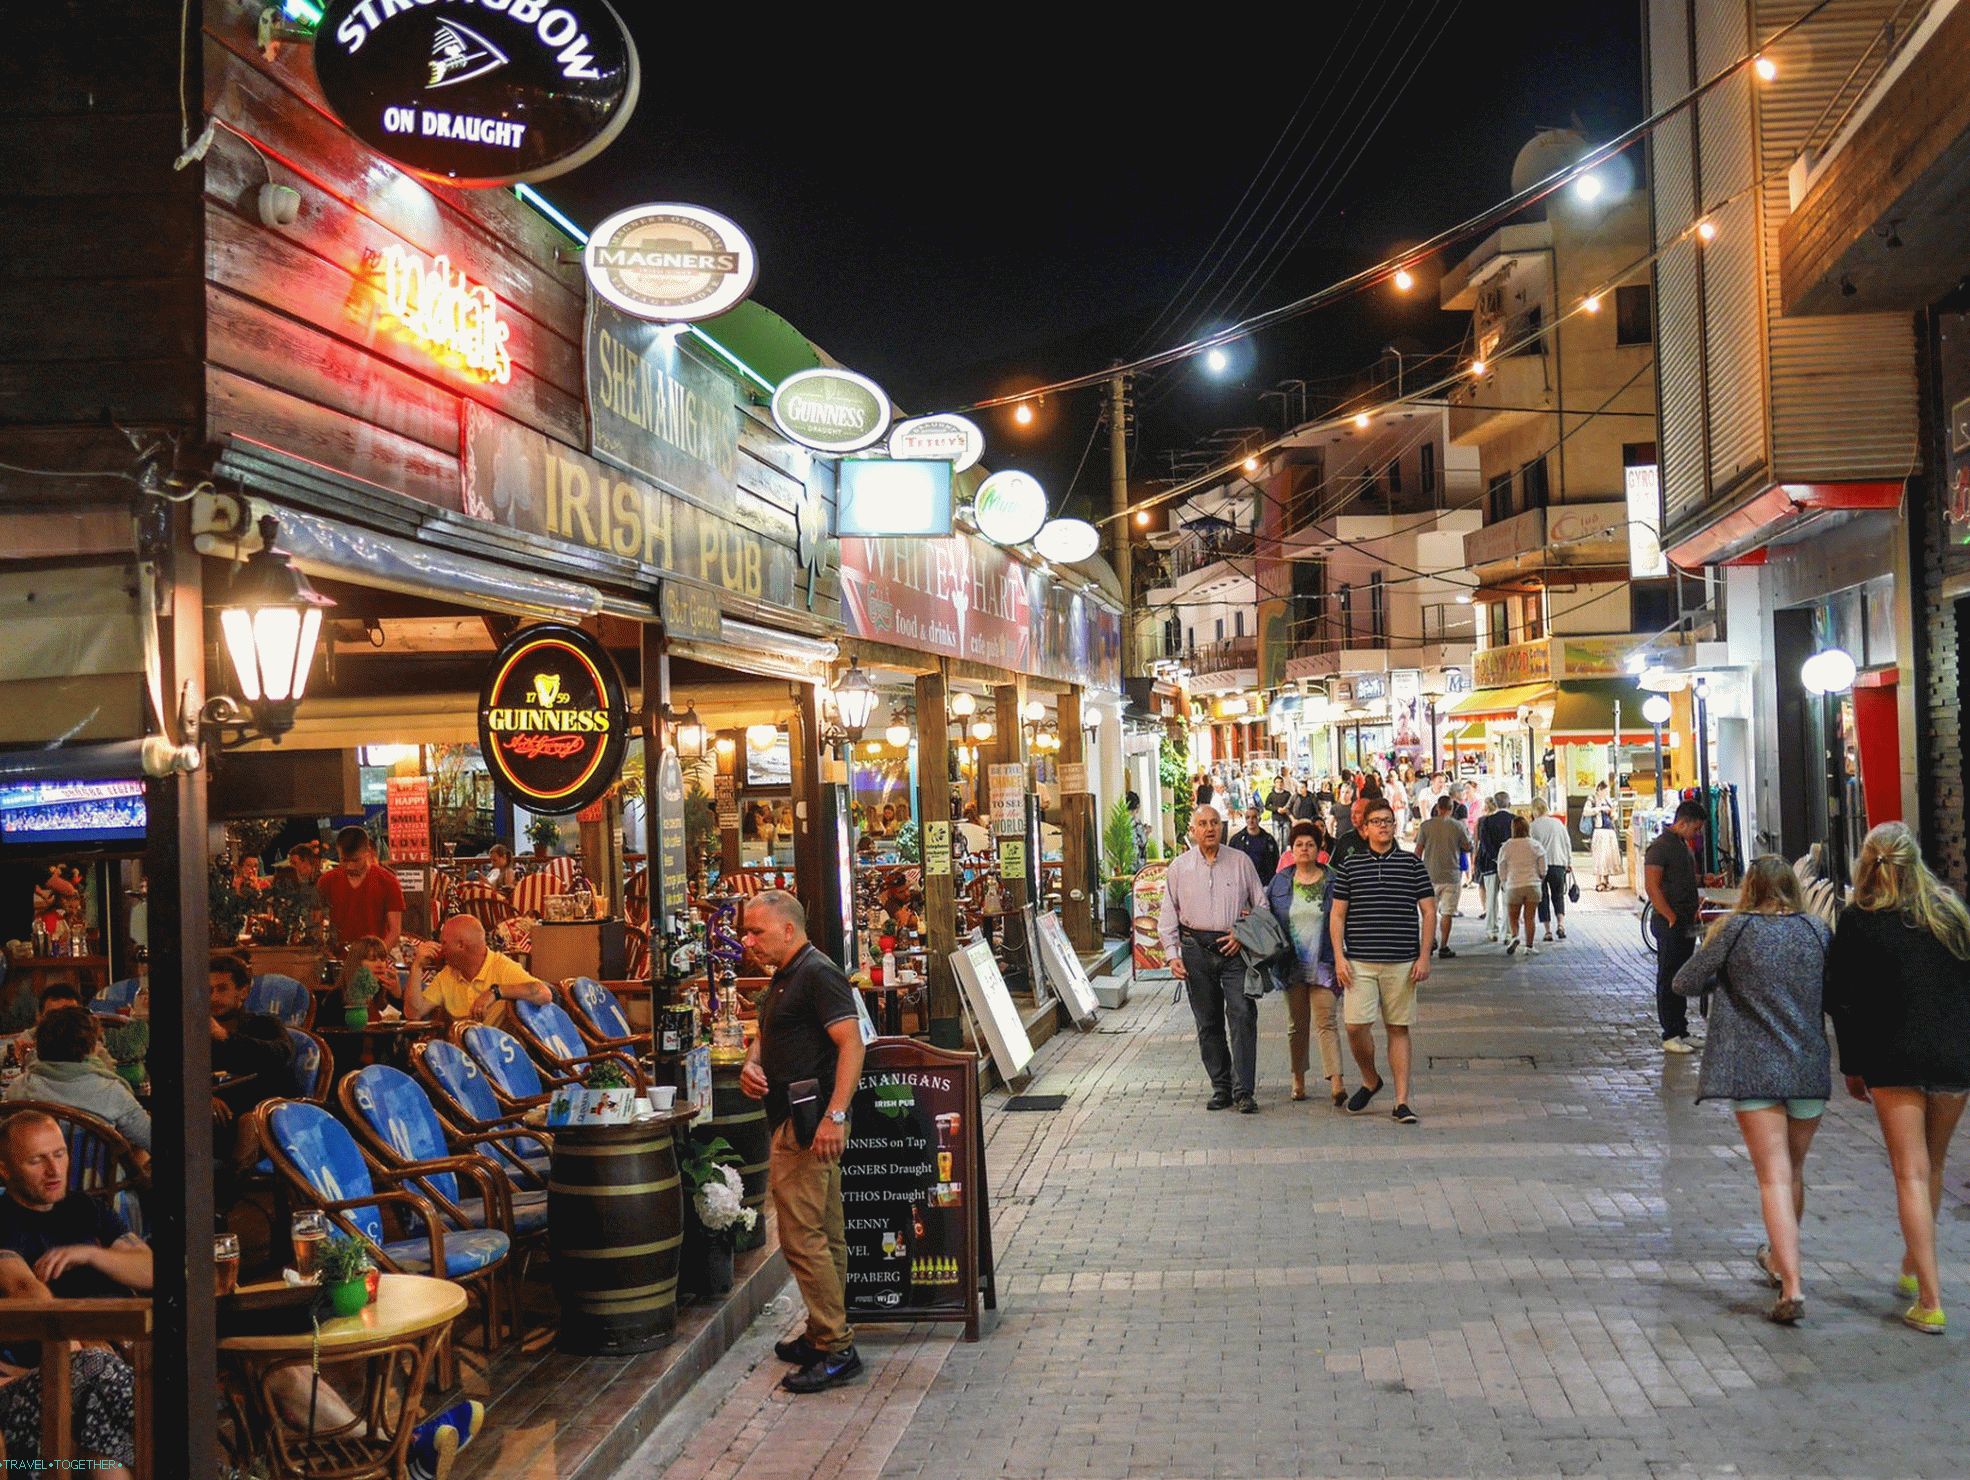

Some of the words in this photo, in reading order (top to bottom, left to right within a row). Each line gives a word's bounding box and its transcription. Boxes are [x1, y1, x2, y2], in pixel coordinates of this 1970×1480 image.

[337, 0, 599, 80] STRBOW
[384, 107, 414, 133] ON
[423, 112, 526, 148] DRAUGHT
[599, 250, 735, 270] MAGNERS
[600, 329, 737, 475] SHENANIGANS
[788, 396, 865, 428] GUINNESS
[543, 453, 675, 570] IRISH
[700, 523, 762, 598] PUB
[864, 538, 950, 600] WHITE
[971, 552, 1018, 622] HART
[896, 609, 918, 639] food
[920, 625, 928, 640] &
[929, 619, 956, 646] drinks
[526, 692, 536, 703] 17
[557, 693, 570, 704] 59
[489, 708, 610, 732] GUINNESS
[991, 767, 1000, 776] BE
[395, 797, 425, 806] HAPPY
[1006, 800, 1023, 808] SEE
[391, 815, 425, 823] SMILE
[992, 818, 1024, 833] WORLD
[391, 839, 428, 848] LOVE
[391, 852, 428, 861] LIVE
[858, 1073, 951, 1092] ENANIGANS
[846, 1138, 888, 1149] INNESS
[890, 1140, 904, 1148] on
[906, 1136, 927, 1149] Tap
[840, 1164, 887, 1176] AGNERS
[890, 1162, 932, 1176] Draught
[840, 1191, 881, 1202] YTHOS
[883, 1189, 926, 1203] Draught
[847, 1218, 890, 1230] KENNY
[847, 1246, 870, 1256] VEL
[846, 1272, 900, 1283] PPABERG
